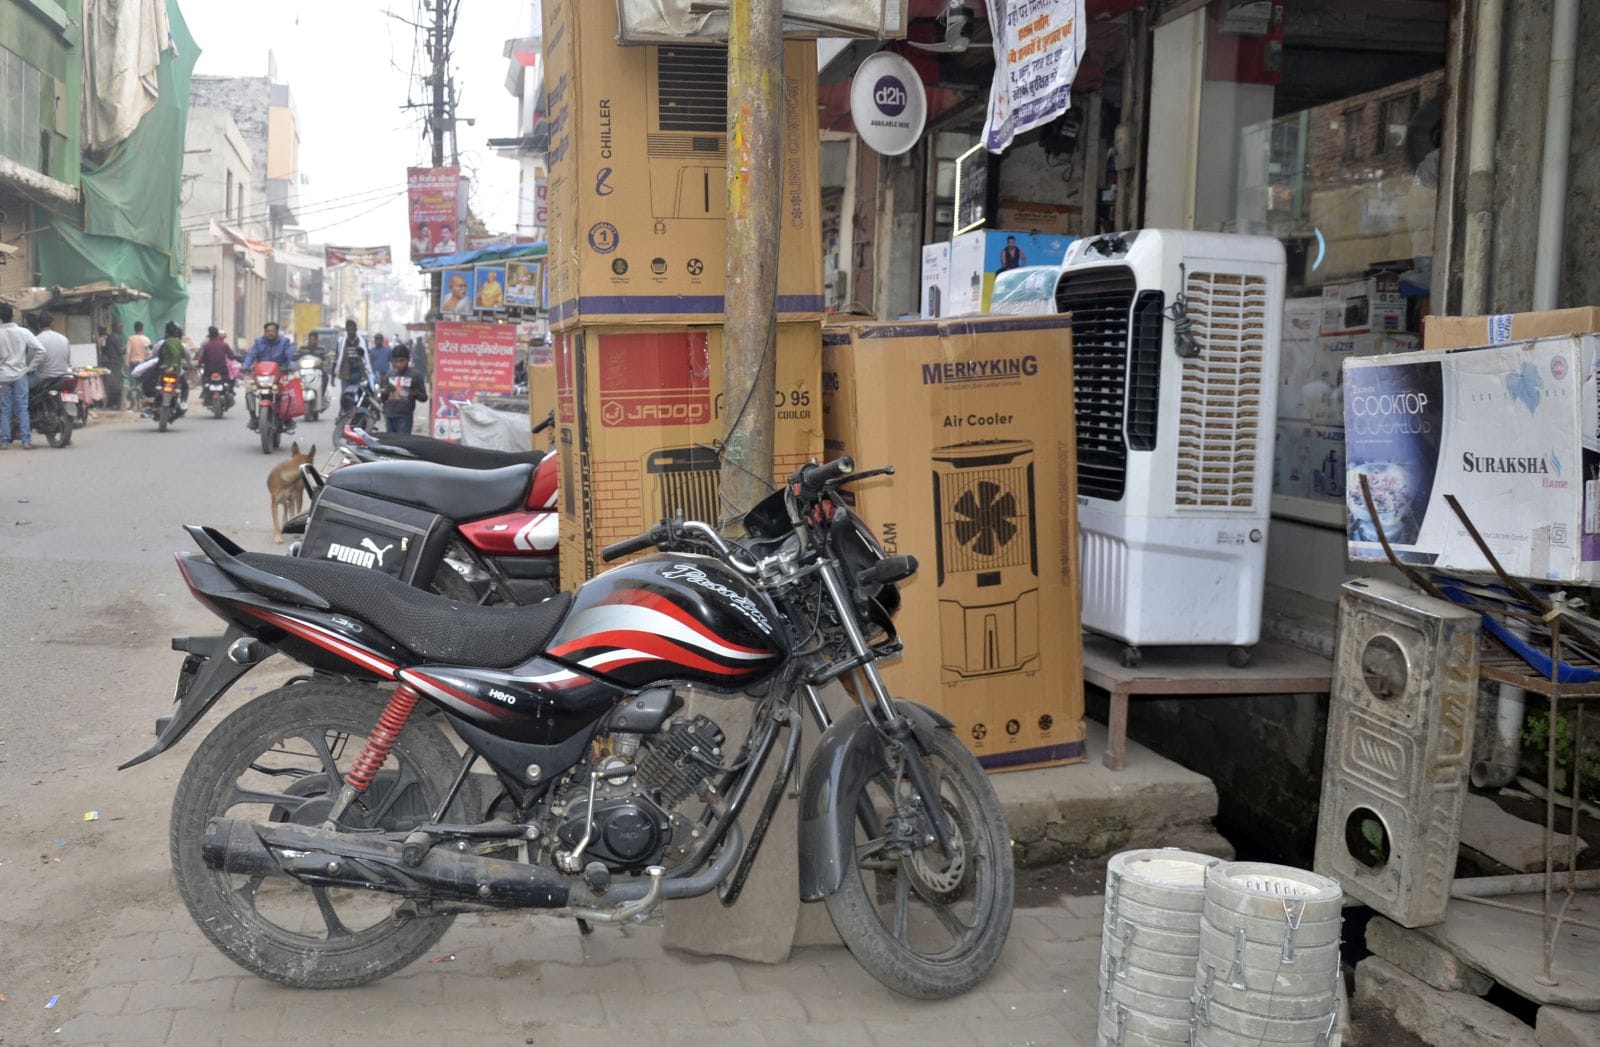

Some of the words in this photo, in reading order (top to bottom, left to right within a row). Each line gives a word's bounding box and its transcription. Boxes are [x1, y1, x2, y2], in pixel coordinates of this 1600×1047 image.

[875, 86, 906, 106] d2h
[599, 99, 612, 159] CHILLER
[921, 355, 1038, 385] MERRYKING
[790, 390, 810, 406] 95
[1352, 393, 1428, 416] COOKTOP
[627, 403, 703, 419] JADOO
[777, 410, 811, 420] COOLER
[943, 415, 963, 428] Air
[967, 413, 1013, 426] Cooler
[1462, 451, 1549, 474] SURAKSHA
[326, 543, 376, 570] PUMA
[489, 688, 516, 704] Hero
